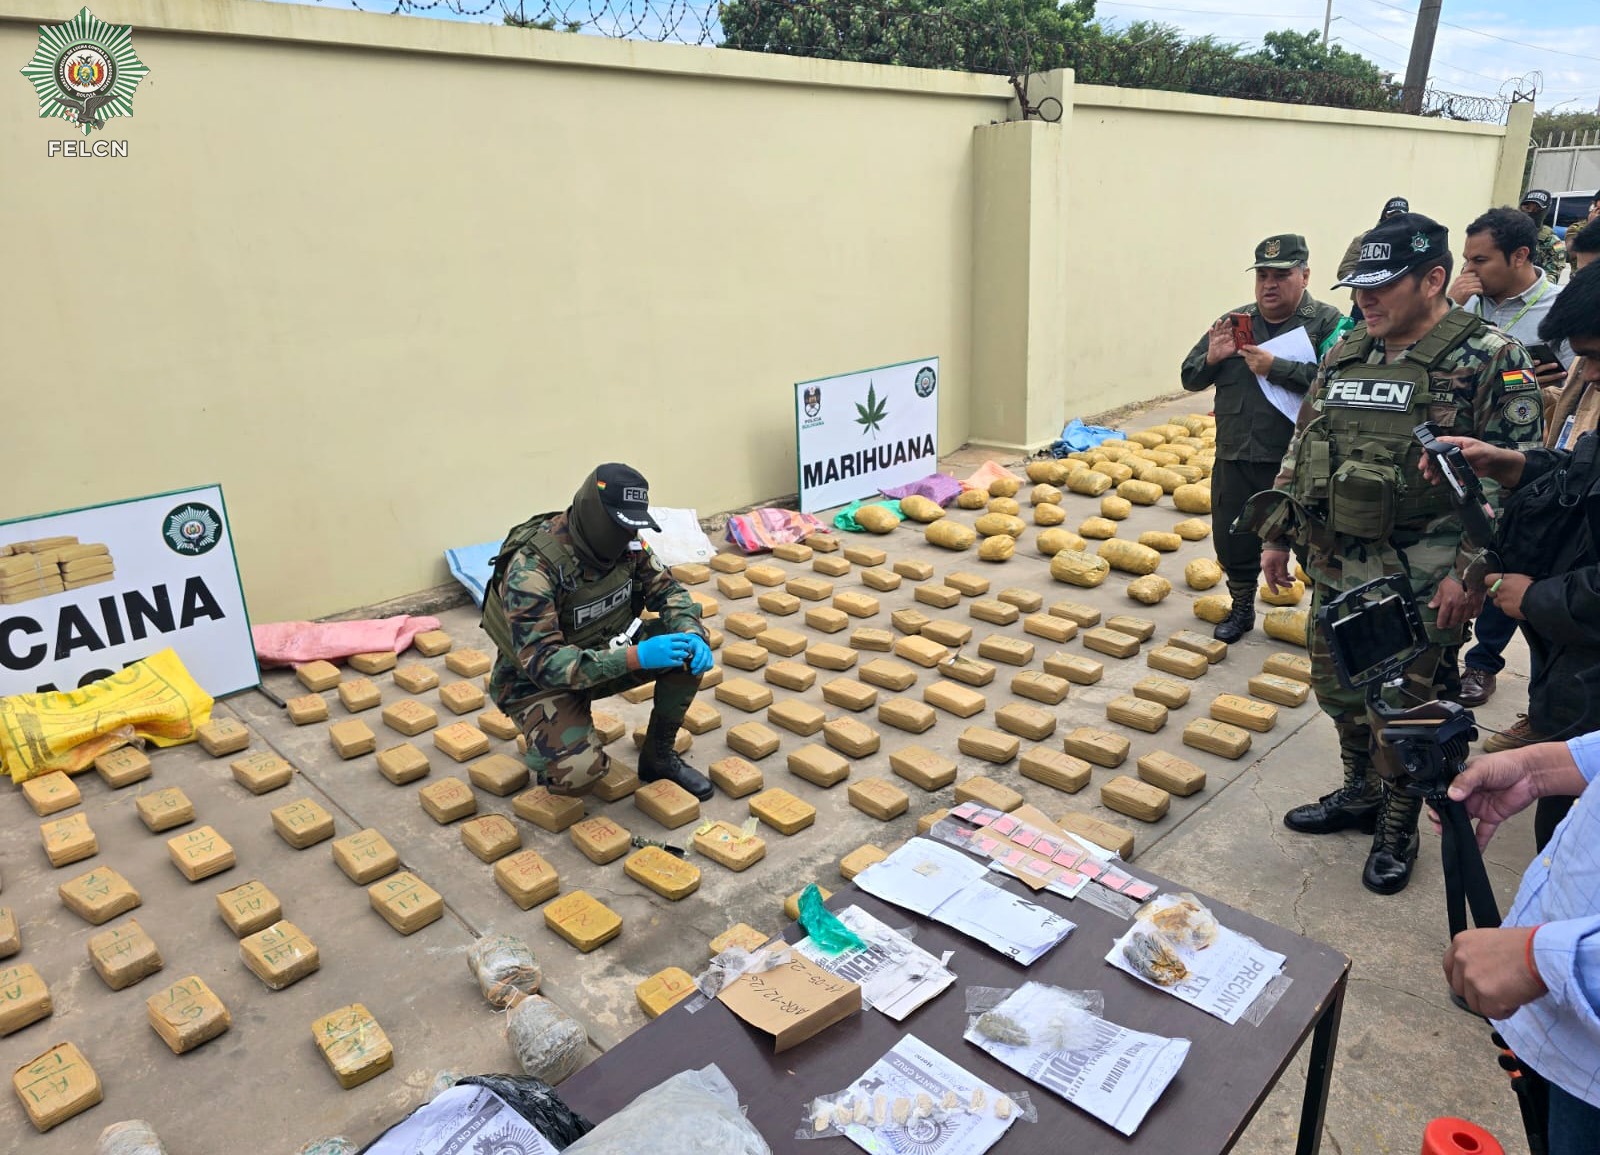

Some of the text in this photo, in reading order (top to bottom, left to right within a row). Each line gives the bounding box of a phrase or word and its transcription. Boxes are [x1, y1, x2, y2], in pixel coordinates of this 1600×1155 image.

[1328, 381, 1410, 404] FELCN
[803, 433, 935, 489] MARIHUANA
[576, 582, 633, 625] FELCN
[0, 575, 226, 671] CAINA
[892, 1057, 915, 1075] CRUZ
[456, 1115, 485, 1143] FELCN
